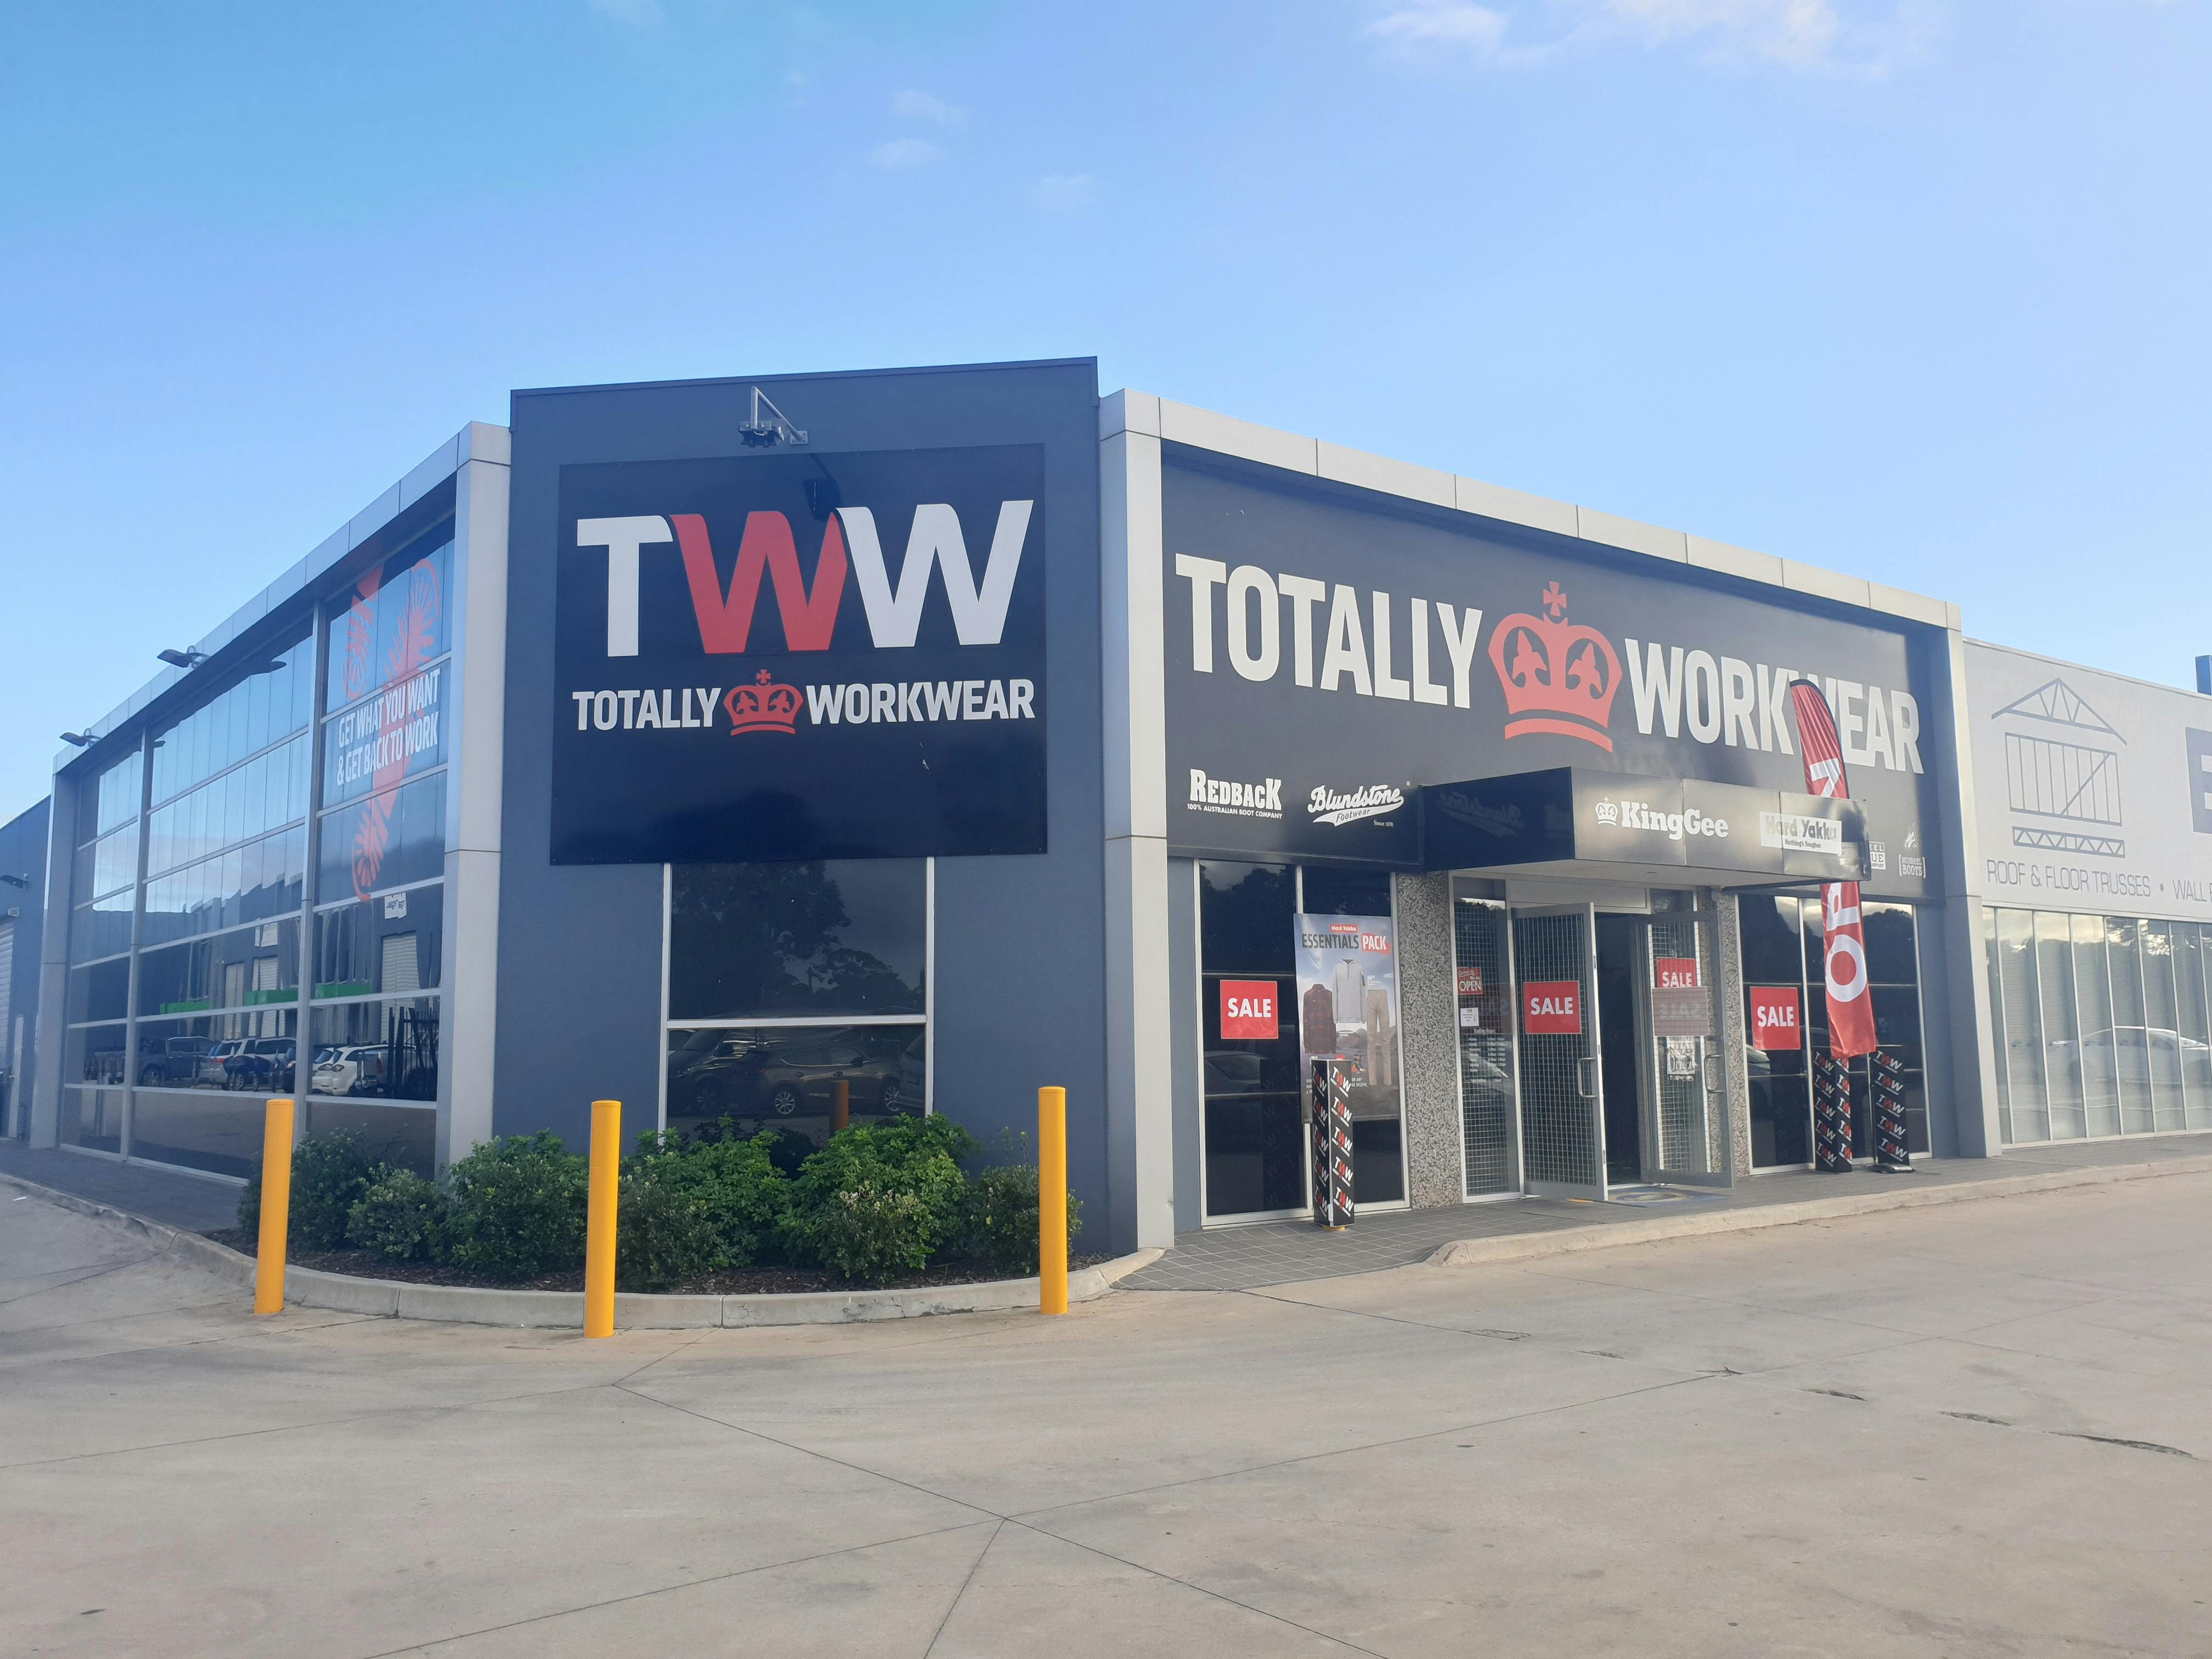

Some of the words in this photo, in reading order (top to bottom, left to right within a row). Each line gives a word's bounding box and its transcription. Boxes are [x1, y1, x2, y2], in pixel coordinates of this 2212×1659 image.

[577, 499, 1034, 657] TWW
[1176, 553, 1483, 709] TOTALLY
[338, 712, 356, 748] GET
[357, 697, 384, 740] WHAT
[385, 685, 406, 725] YOU
[408, 668, 440, 714] WANT
[572, 688, 721, 731] TOTALLY
[806, 679, 1035, 725] WORKWEAR
[337, 755, 344, 786] &
[346, 747, 363, 782] GET
[364, 733, 389, 775] BACK
[390, 727, 403, 763] TO
[405, 711, 439, 757] WORK
[1307, 785, 1404, 813] Blundstone
[1204, 806, 1238, 815] AUSTRALIAN
[1255, 811, 1282, 820] COMPANY
[1336, 809, 1370, 823] Footwear
[1621, 801, 1729, 840] KingGee
[1765, 815, 1797, 837] Hard
[1801, 819, 1836, 840] Yakka
[1871, 853, 1883, 862] UE
[1902, 864, 1922, 876] BOOTS
[1987, 859, 2025, 885] ROOF
[2031, 865, 2042, 887] &
[2045, 865, 2089, 891] FLOOR
[2092, 871, 2151, 897] TRUSSES
[2172, 878, 2207, 902] WALL
[1302, 933, 1359, 949] ESSENTIALS
[1362, 935, 1387, 950] PACK
[1459, 980, 1481, 991] OPEN
[1662, 972, 1692, 987] SALE
[1227, 997, 1272, 1018] SALE
[1530, 997, 1573, 1015] SALE
[1757, 1006, 1794, 1028] SALE
[1333, 1066, 1351, 1092] TWW
[1334, 1097, 1352, 1121] TWW
[1334, 1126, 1352, 1152] TWW
[1335, 1156, 1353, 1181] TWW
[1336, 1187, 1353, 1211] TWW
